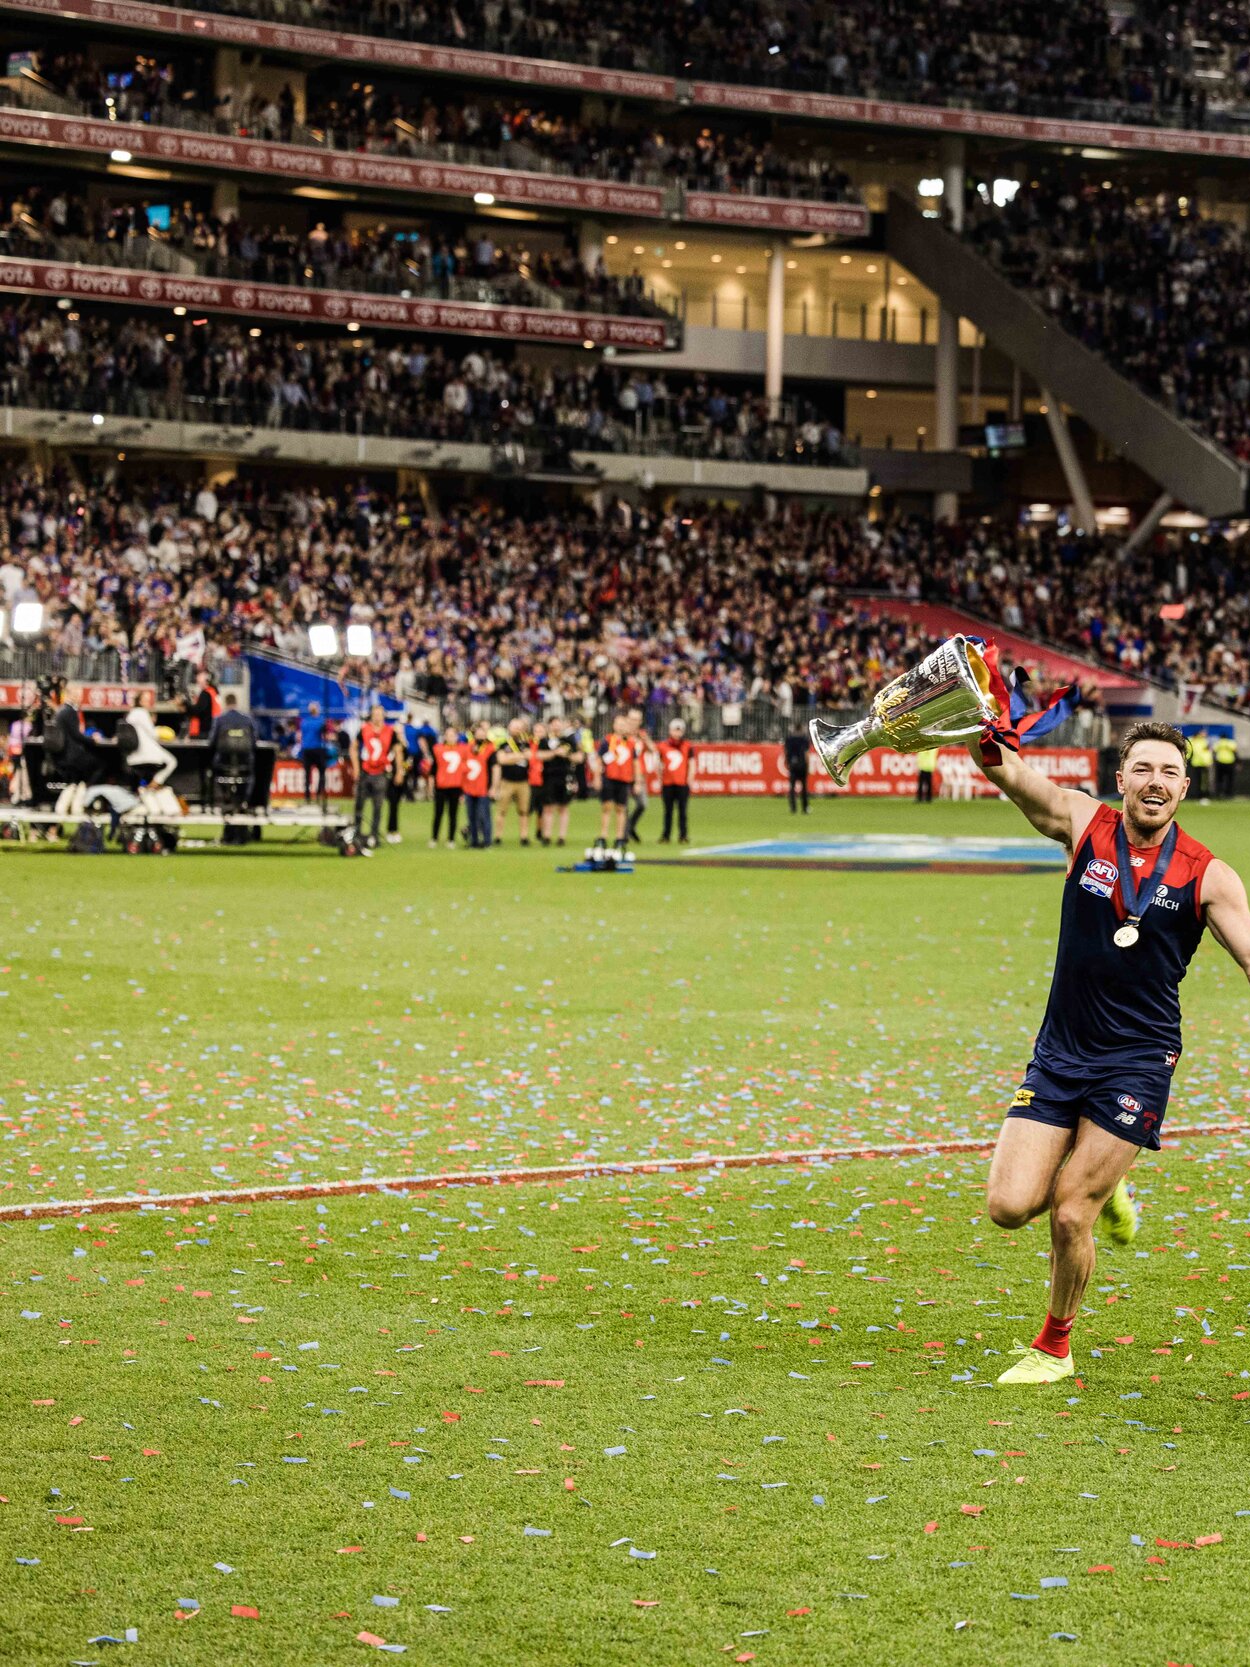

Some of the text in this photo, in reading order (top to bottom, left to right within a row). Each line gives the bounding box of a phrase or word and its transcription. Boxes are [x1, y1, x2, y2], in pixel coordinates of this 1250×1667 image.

[0, 117, 49, 137] OYOTA
[88, 127, 144, 149] TOYOTA
[181, 139, 236, 161] TOYOTA
[358, 162, 413, 182] TOYOTA
[0, 266, 35, 286] YOTA
[71, 272, 130, 295] TOYOTA
[165, 281, 221, 303] TOYOTA
[258, 290, 312, 312] TOYOTA
[351, 300, 408, 321] TOYOTA
[439, 308, 495, 329] TOYOTA
[697, 752, 763, 775] FEELING
[1090, 862, 1115, 881] AFL
[1149, 896, 1180, 911] URICH
[1120, 1096, 1141, 1111] AFL
